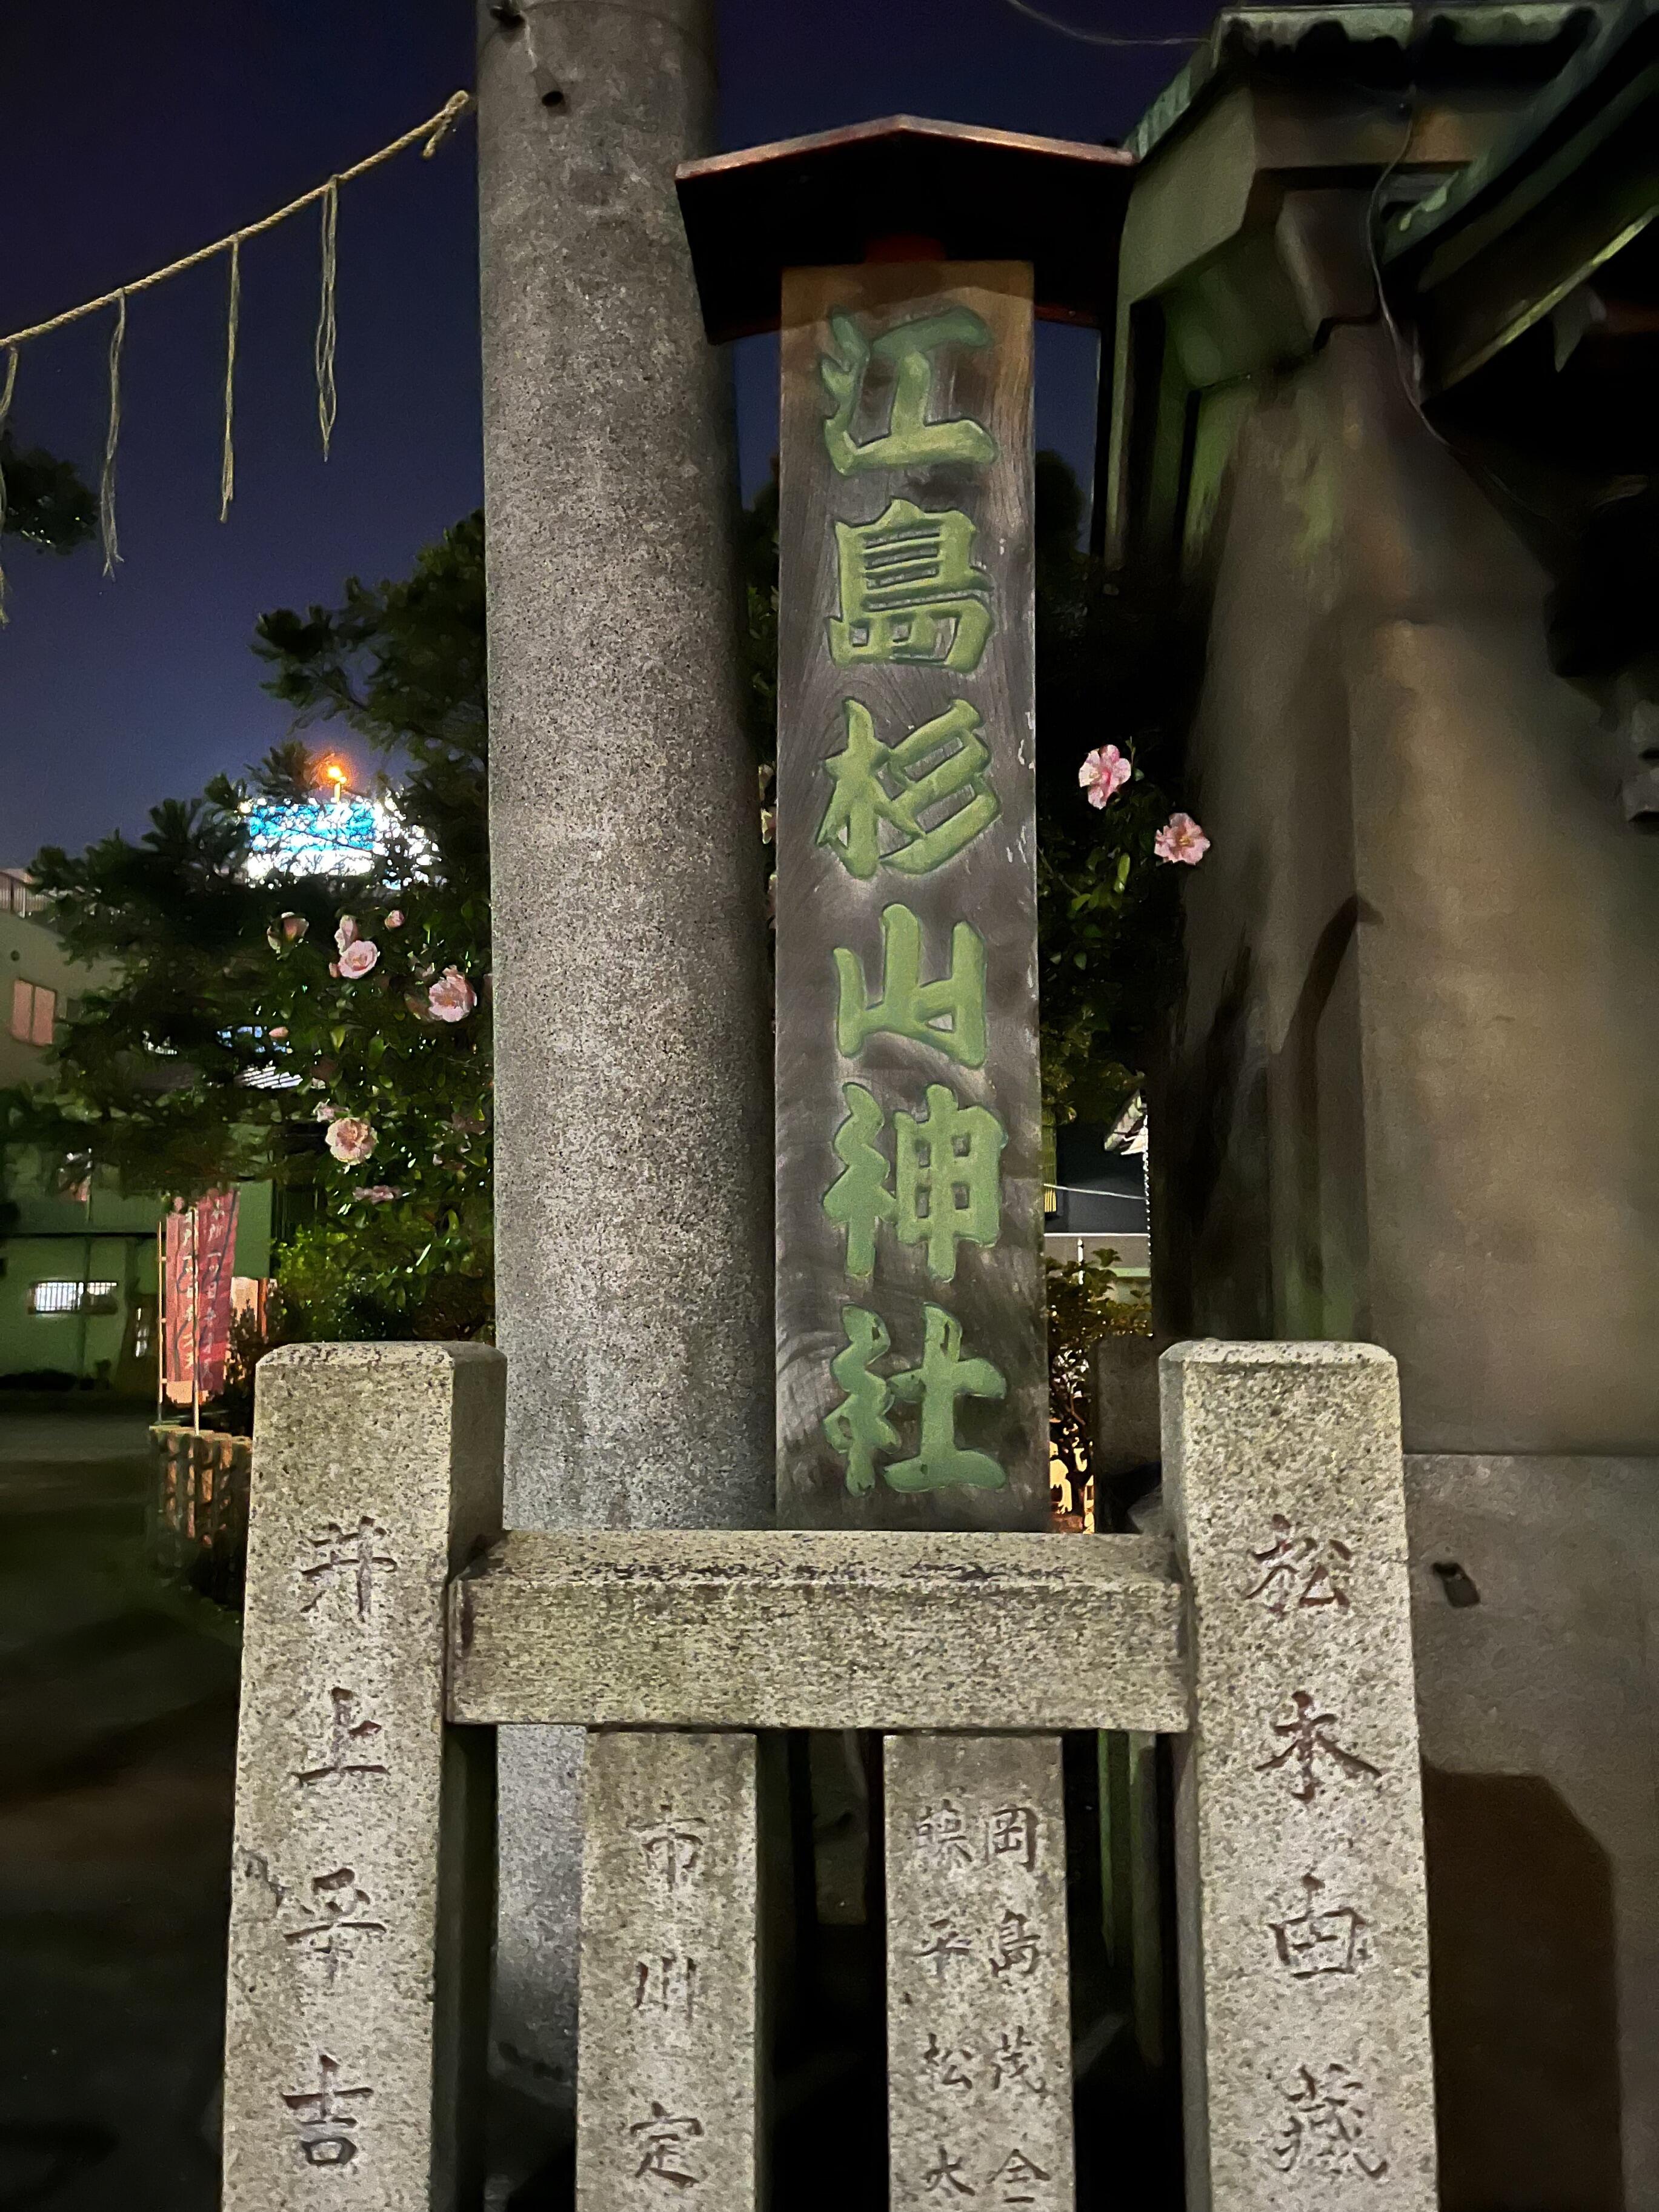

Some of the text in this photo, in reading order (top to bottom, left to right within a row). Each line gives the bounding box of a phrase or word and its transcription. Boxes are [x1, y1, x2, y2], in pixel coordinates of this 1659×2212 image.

[816, 305, 1008, 1496] 江島杉山神社
